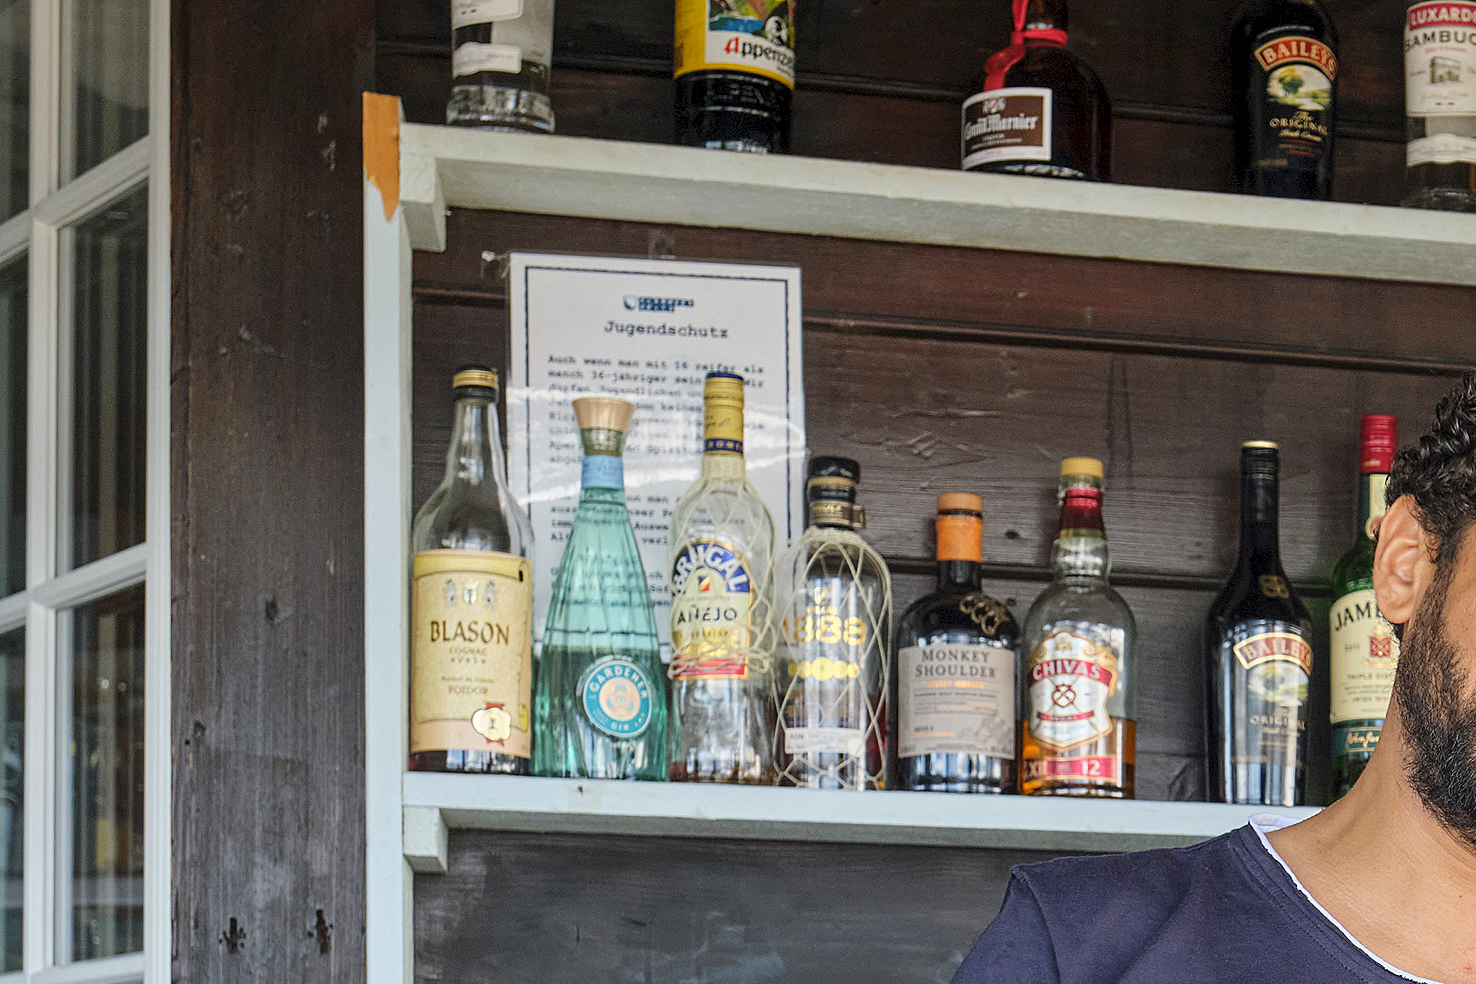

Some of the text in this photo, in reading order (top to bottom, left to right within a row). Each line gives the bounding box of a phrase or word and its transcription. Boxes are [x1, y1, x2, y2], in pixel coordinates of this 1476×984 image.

[1261, 41, 1335, 71] BAILEYS
[603, 320, 729, 339] Jugendschutz
[583, 357, 612, 367] wenn
[617, 358, 640, 368] man
[646, 359, 667, 369] mit
[430, 620, 510, 646] BLASON
[783, 615, 867, 647] 1888
[920, 649, 990, 663] MONKEY
[1243, 637, 1315, 667] BAILEYS
[589, 665, 648, 699] GARDENER
[914, 664, 998, 679] SHOULDER
[1032, 658, 1101, 682] CHIVAS
[1081, 759, 1101, 776] 12
